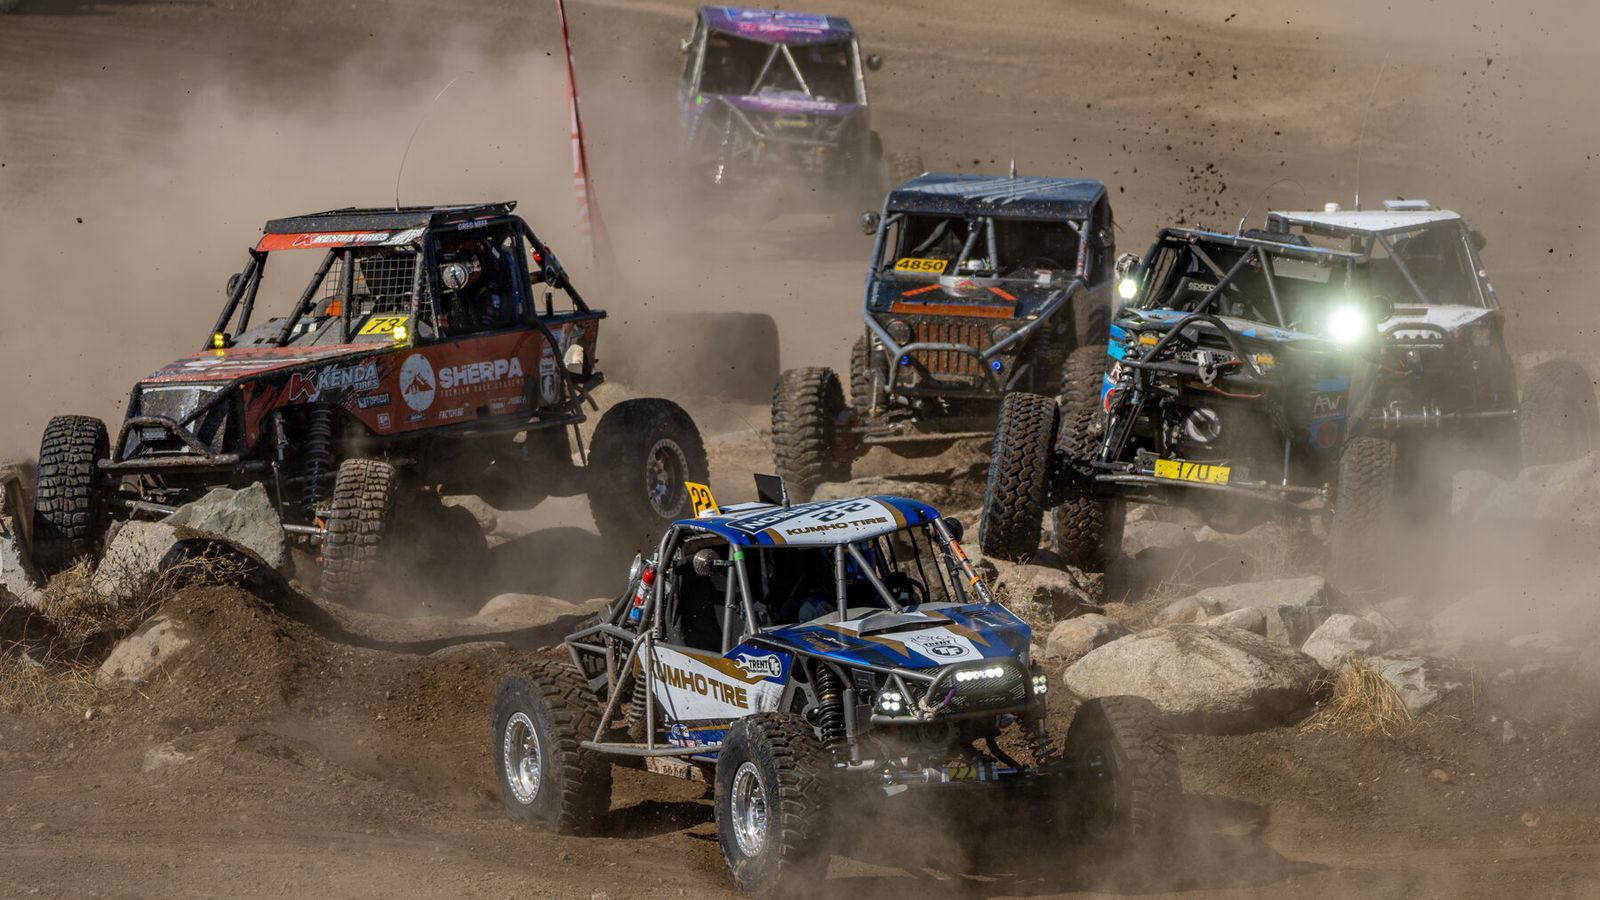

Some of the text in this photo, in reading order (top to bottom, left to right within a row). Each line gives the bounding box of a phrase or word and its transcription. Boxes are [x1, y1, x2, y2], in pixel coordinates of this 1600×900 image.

[313, 233, 354, 243] KENDA
[355, 232, 390, 242] TIRES
[897, 260, 945, 272] 4850
[1188, 281, 1217, 292] sparc
[317, 362, 379, 389] KENDA
[438, 356, 524, 389] SHERPA
[354, 379, 380, 390] TIRES
[691, 486, 713, 517] 22
[786, 516, 889, 536] KUMHO TIRE
[923, 640, 951, 648] TRENT
[748, 659, 769, 669] TRENT
[652, 660, 749, 710] UMHO TIRE
